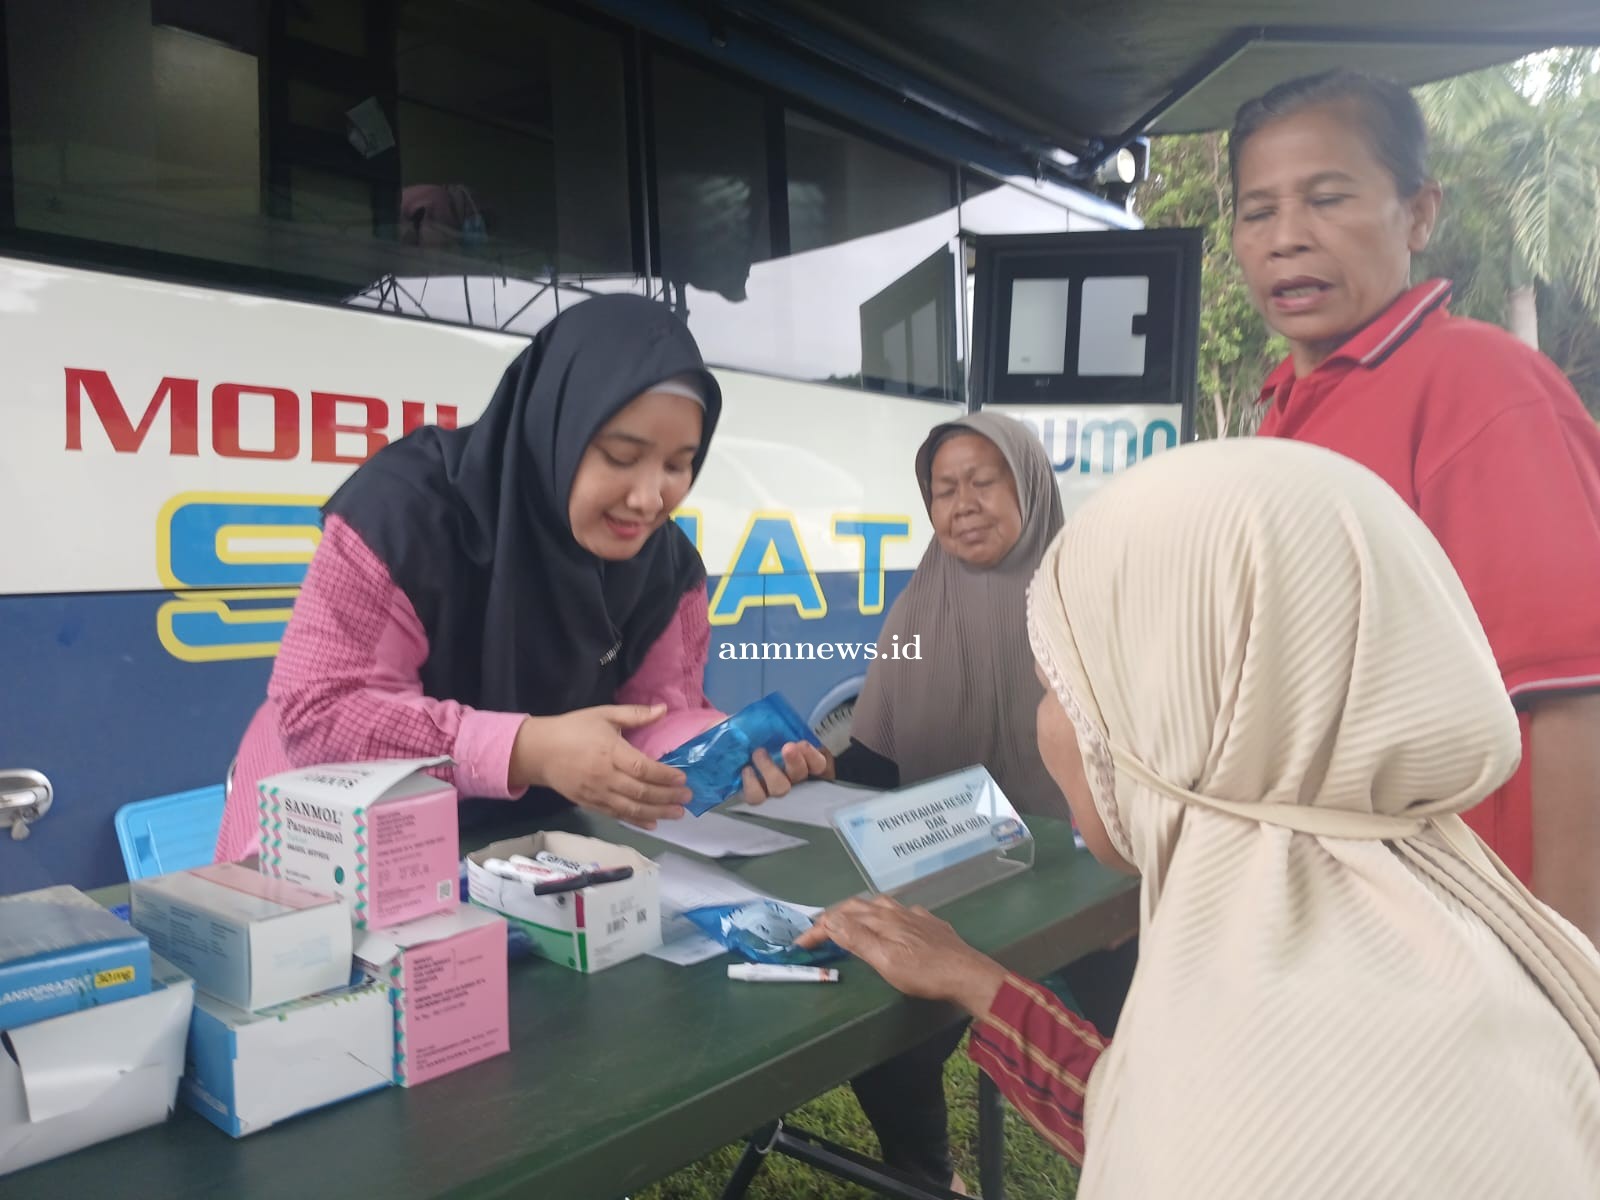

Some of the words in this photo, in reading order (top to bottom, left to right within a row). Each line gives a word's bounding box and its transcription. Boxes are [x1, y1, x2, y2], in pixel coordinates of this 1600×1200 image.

[155, 491, 912, 663] SAT
[285, 797, 341, 825] SANMOL
[876, 801, 945, 832] PENYERAHAN
[944, 790, 974, 812] RESEP
[925, 815, 948, 831] DAN
[286, 818, 343, 844] Paracetamol
[892, 821, 966, 858] PENGAMBILAN
[963, 815, 991, 834] OBAT
